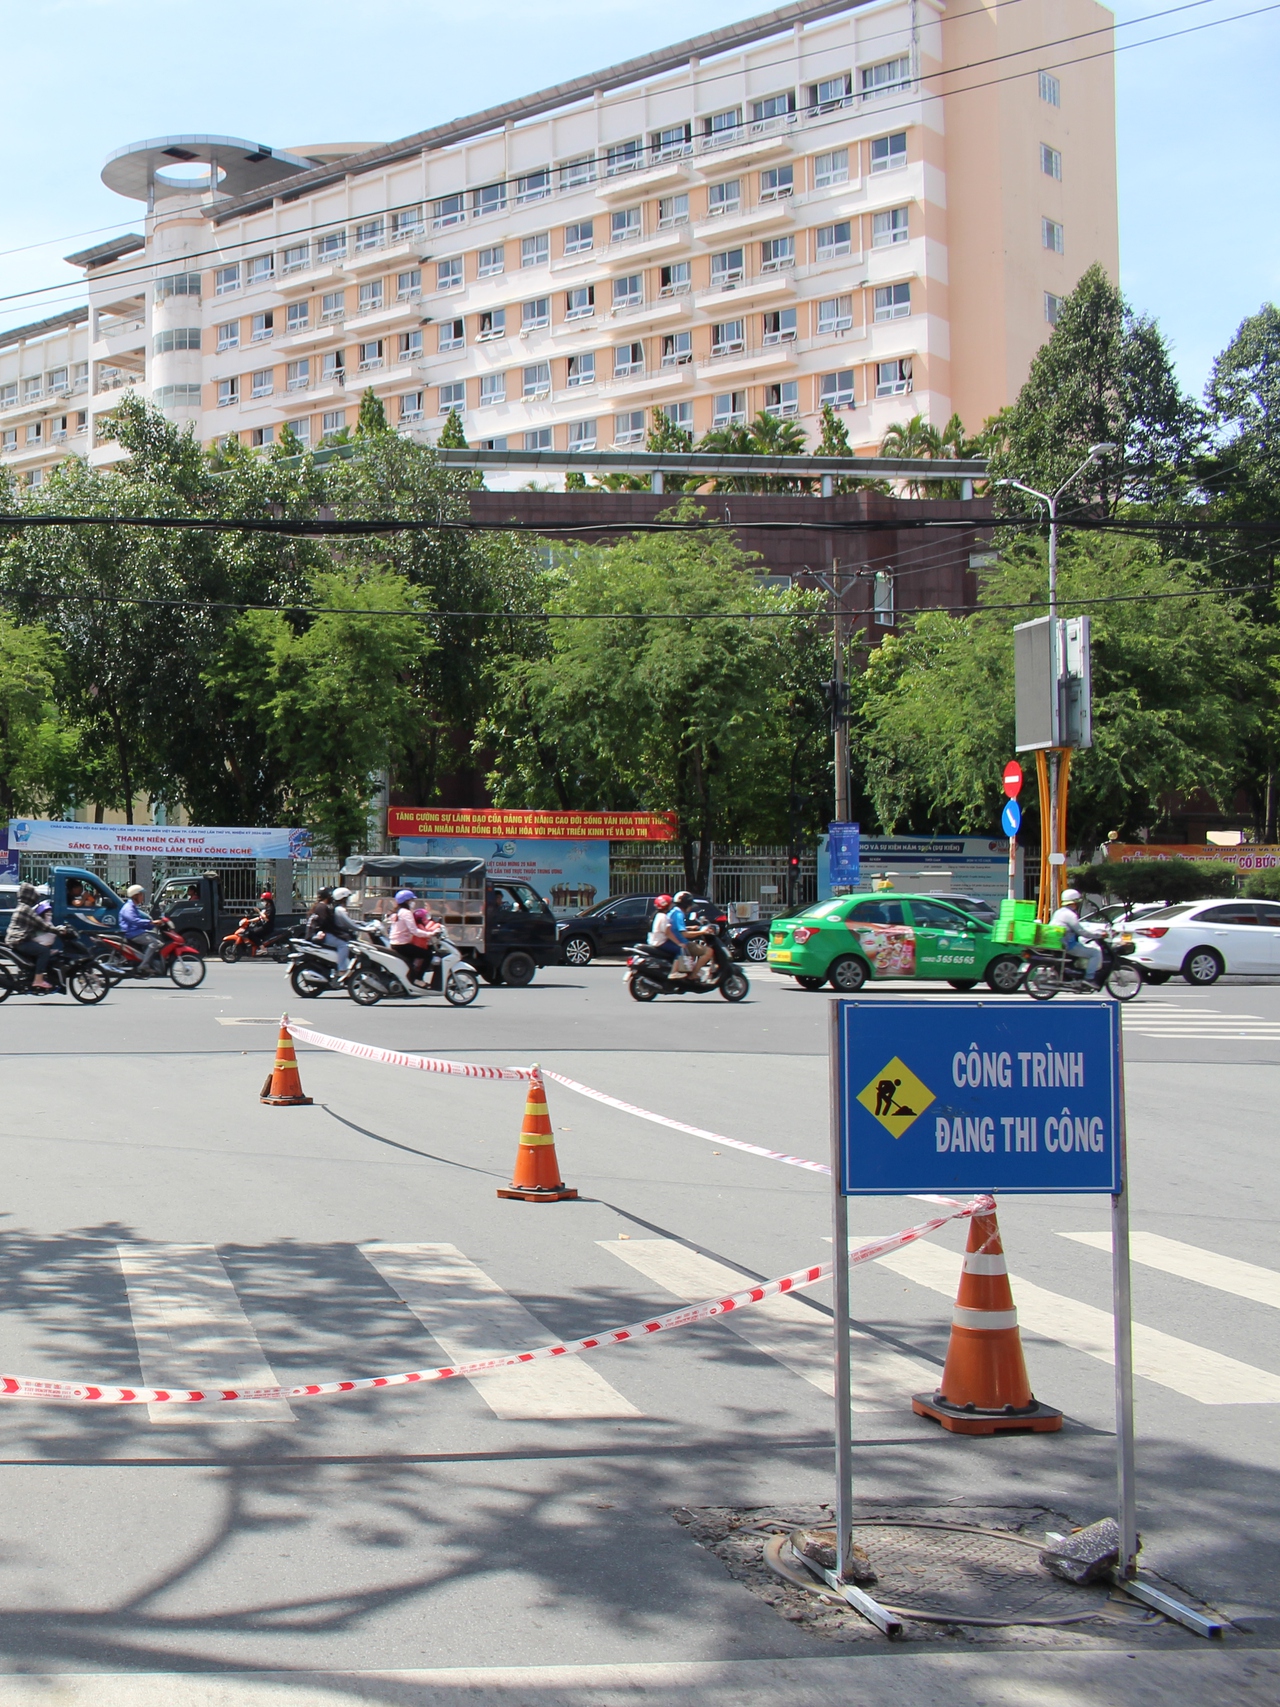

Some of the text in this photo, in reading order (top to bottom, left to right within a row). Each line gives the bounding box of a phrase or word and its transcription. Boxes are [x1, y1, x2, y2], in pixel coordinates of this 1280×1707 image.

[68, 842, 90, 850] SÁNG
[93, 843, 111, 852] TẠO,
[185, 845, 202, 853] CHỦ
[204, 846, 227, 854] CÔNG
[230, 846, 252, 856] NGHỆ
[1239, 853, 1254, 869] CỐ
[1255, 853, 1277, 869] BỨC
[952, 1042, 1083, 1088] CÔNG TRÌNH
[935, 1107, 1104, 1153] ĐANG THI CÔNG
